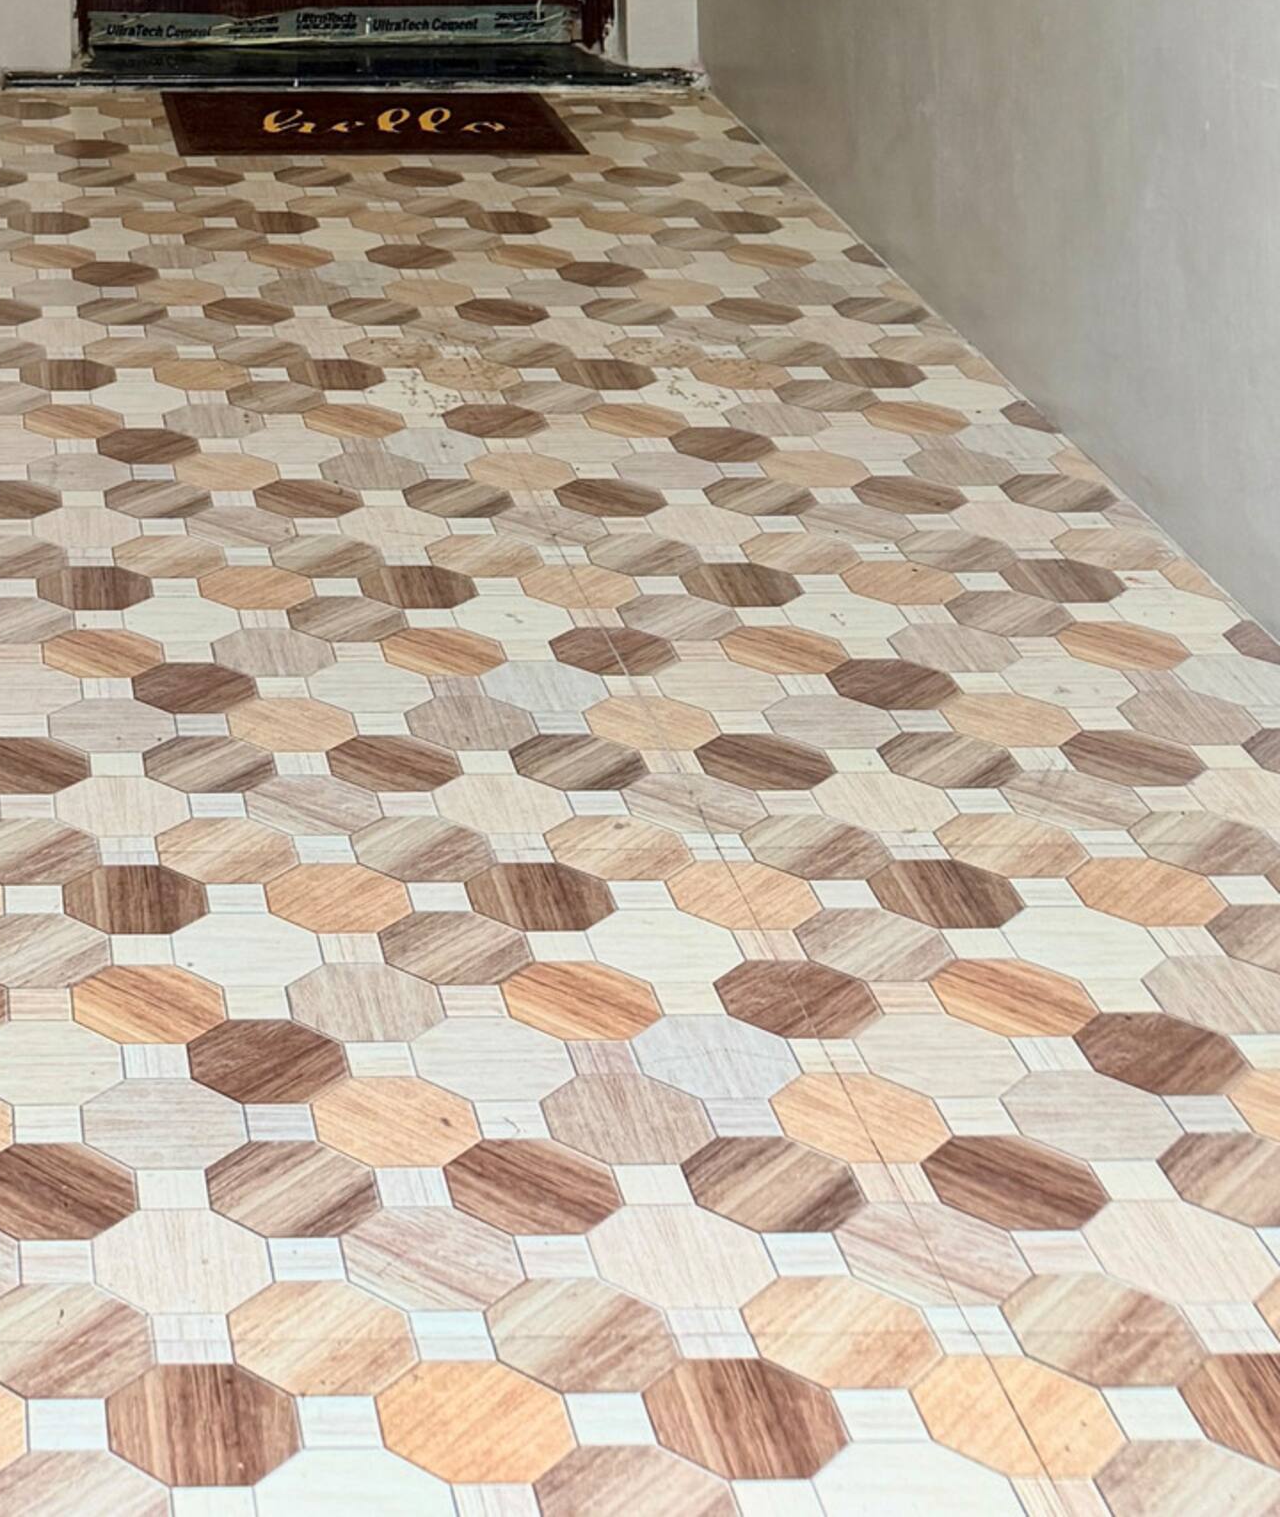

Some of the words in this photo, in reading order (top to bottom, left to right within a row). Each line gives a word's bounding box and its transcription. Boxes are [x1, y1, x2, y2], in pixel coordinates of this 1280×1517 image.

[106, 23, 163, 37] UltraTech
[373, 19, 429, 32] UltraTech
[432, 18, 478, 31] Cement
[262, 107, 510, 133] hello
